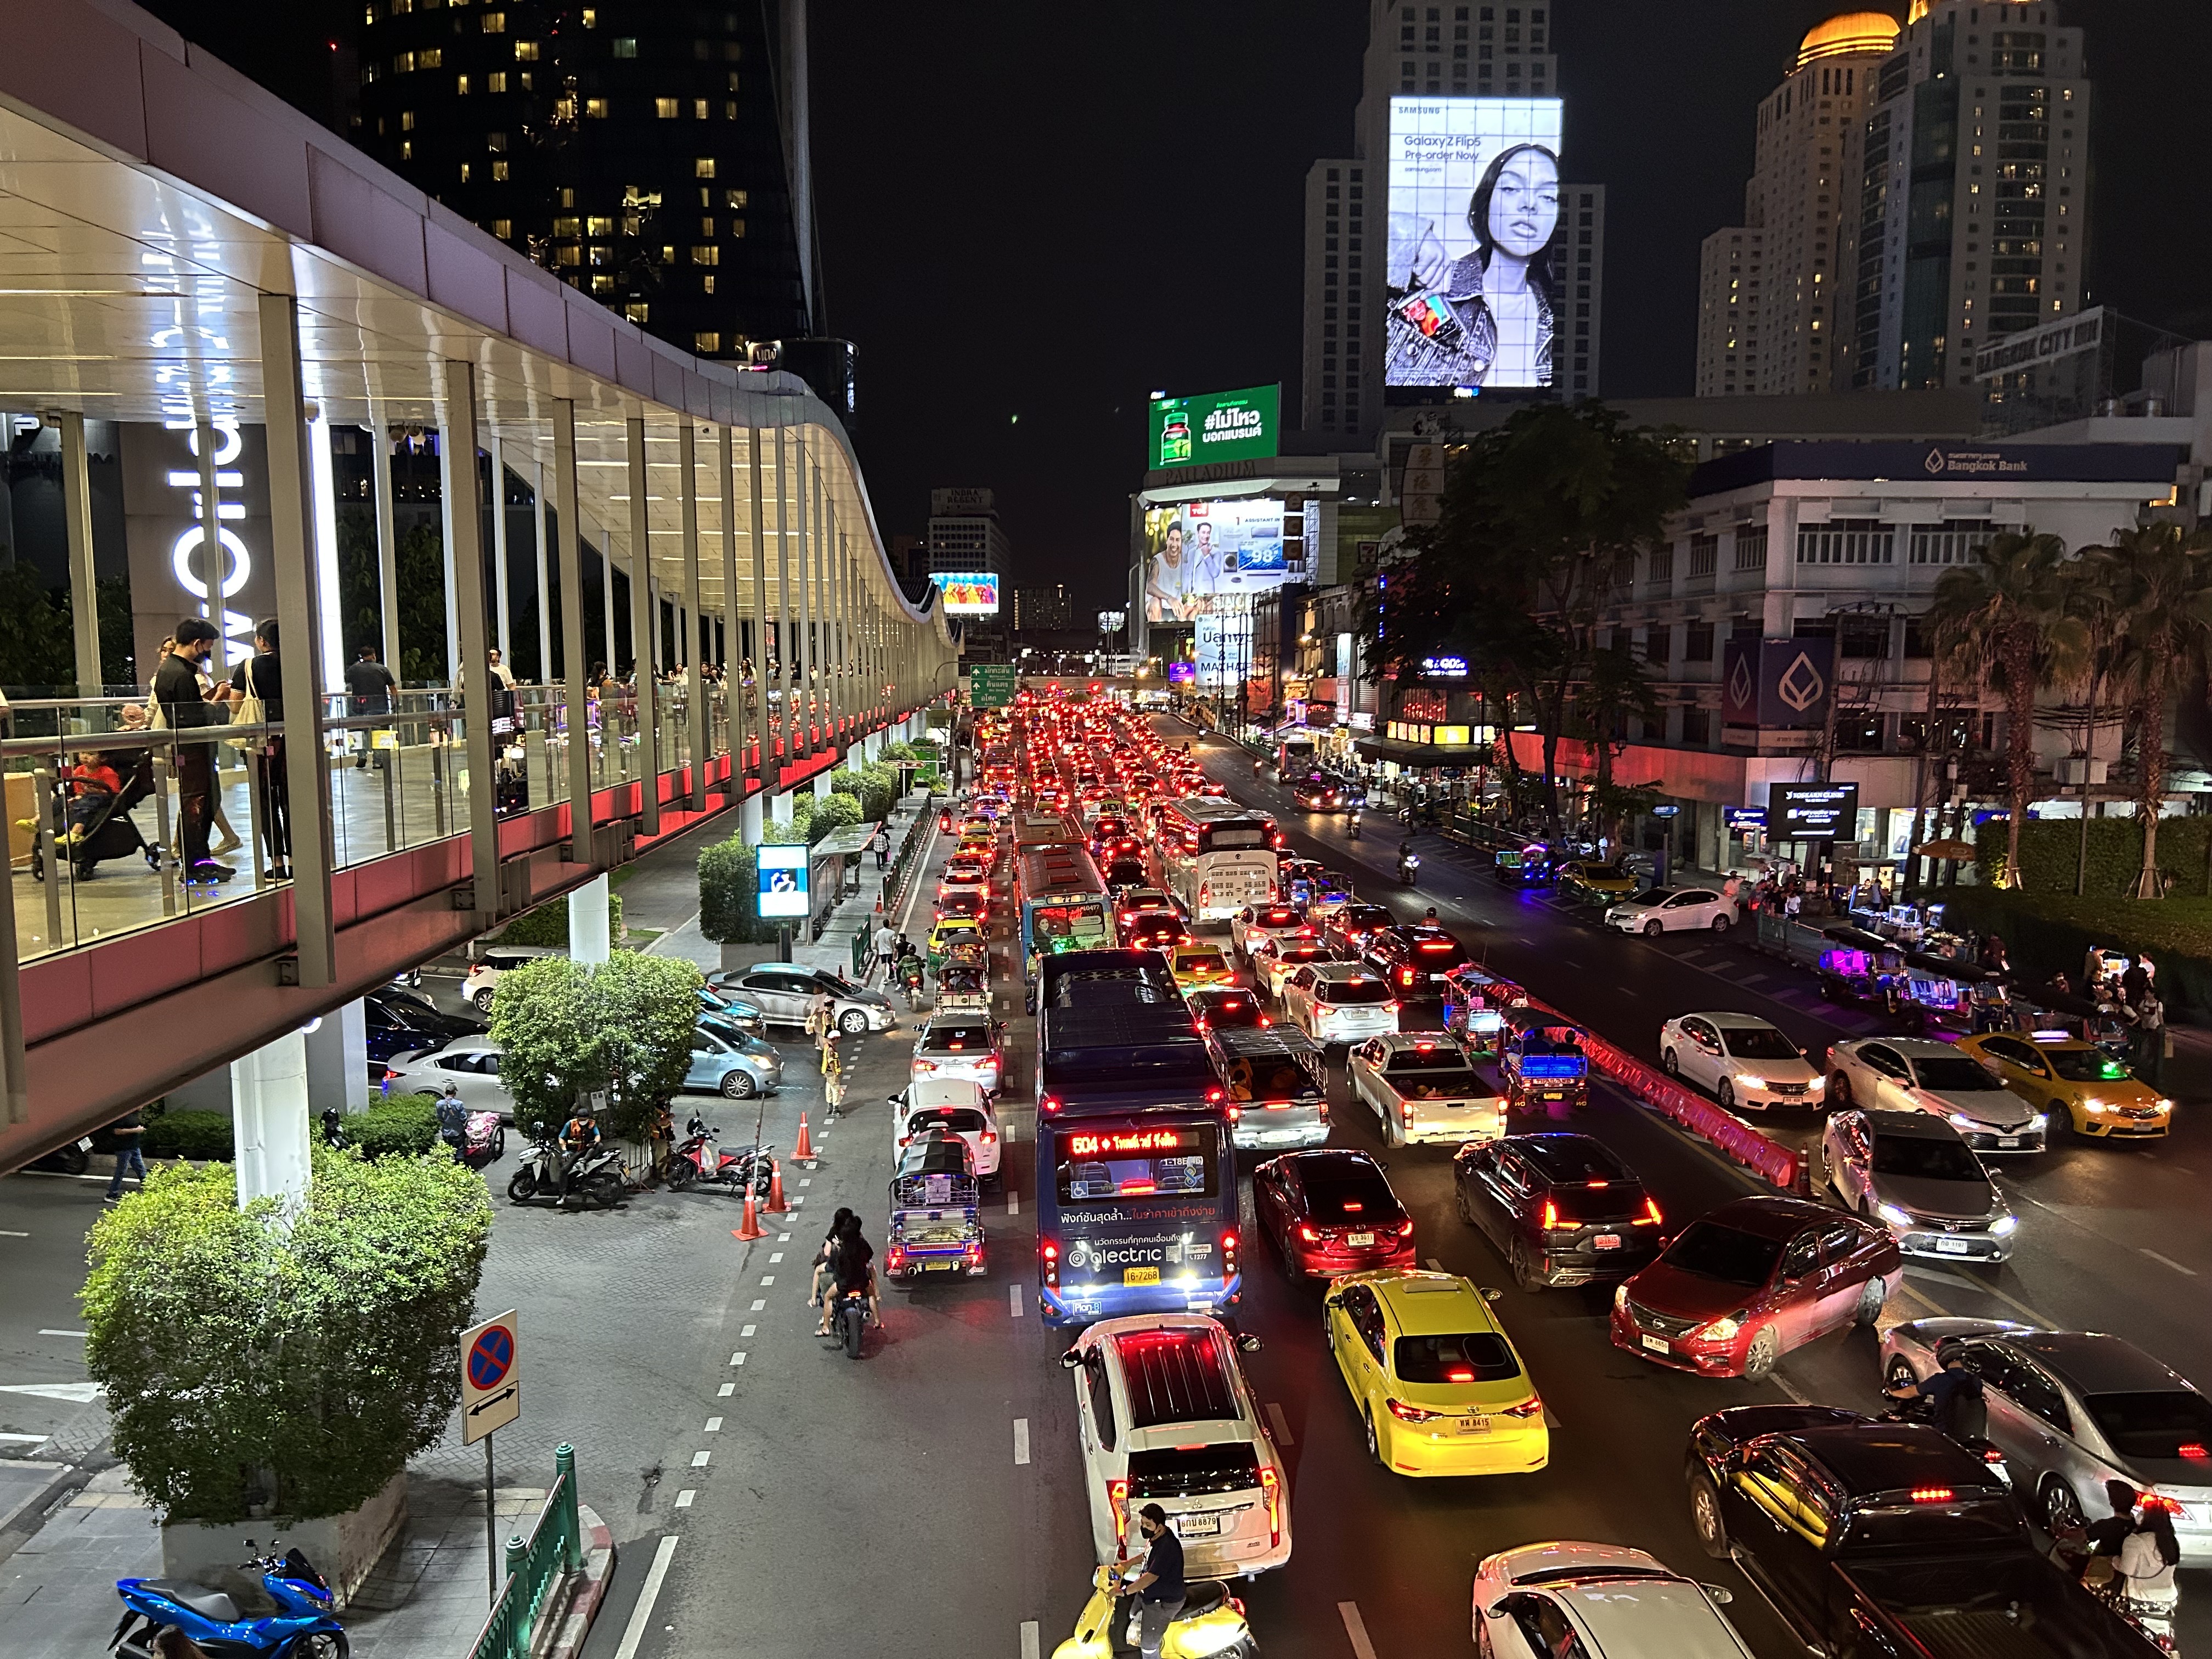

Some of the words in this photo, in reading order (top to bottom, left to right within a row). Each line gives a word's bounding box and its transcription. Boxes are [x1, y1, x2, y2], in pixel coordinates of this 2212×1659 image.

[1404, 136, 1446, 149] Galaxy
[1447, 137, 1454, 146] Z
[1455, 137, 1481, 150] Flip5
[1405, 150, 1454, 159] Pre-order
[1456, 151, 1479, 160] Now
[1948, 460, 1996, 473] Bangkok
[1999, 461, 2028, 471] Bank
[1073, 1136, 1099, 1155] 504
[1198, 1517, 1216, 1526] 8879
